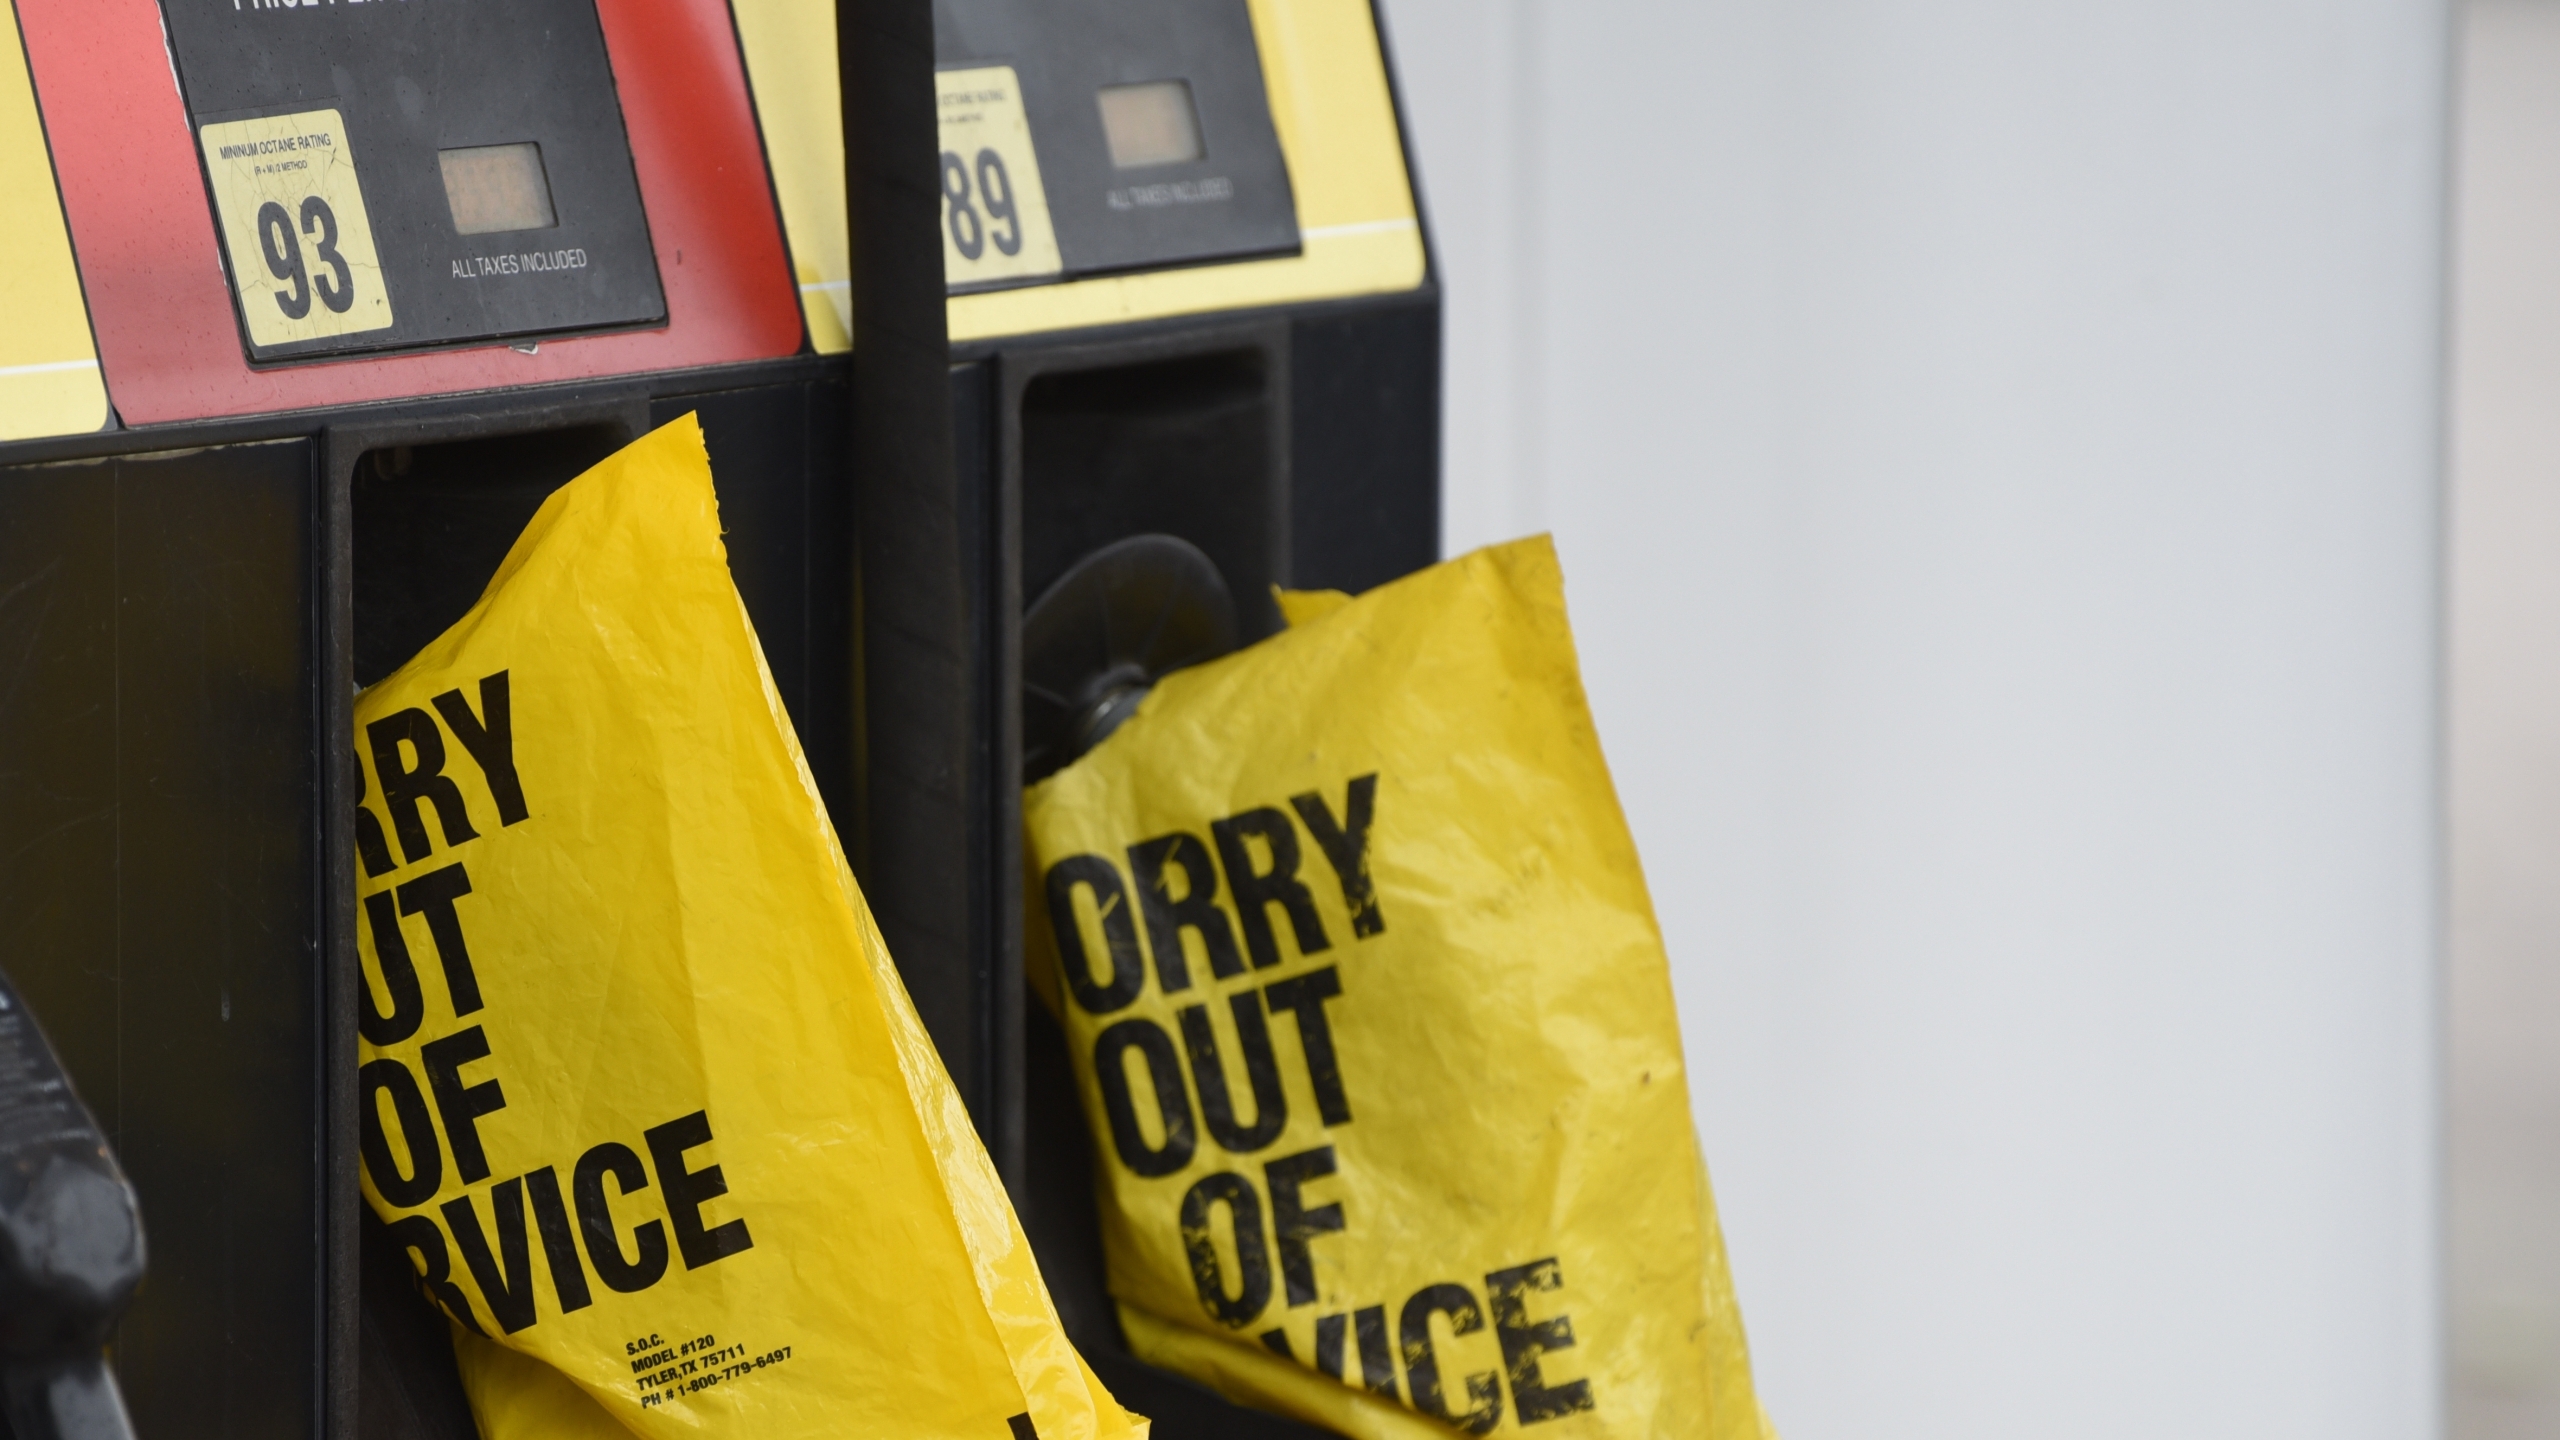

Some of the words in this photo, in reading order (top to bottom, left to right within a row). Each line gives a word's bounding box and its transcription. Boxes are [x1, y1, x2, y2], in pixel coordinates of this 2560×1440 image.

[259, 137, 297, 155] OCTANE
[297, 132, 332, 150] RATING
[281, 160, 308, 172] METHOD
[940, 147, 1022, 261] 89
[257, 195, 355, 321] 93
[452, 258, 477, 279] ALL
[475, 254, 520, 277] TAXES
[520, 248, 588, 273] INCLUDED
[1044, 771, 1387, 1018] ORRY
[1091, 963, 1354, 1180] OUT
[358, 1023, 507, 1209] OF
[1179, 1144, 1346, 1331] OF
[625, 1333, 665, 1356] S.O.C.
[630, 1347, 679, 1374] MODEL
[680, 1334, 716, 1358] #120
[635, 1360, 699, 1392] TYLER,TX
[700, 1343, 746, 1370] 75711
[640, 1392, 662, 1410] PH
[665, 1388, 675, 1403] #
[677, 1346, 793, 1398] 1-800-779-6497
